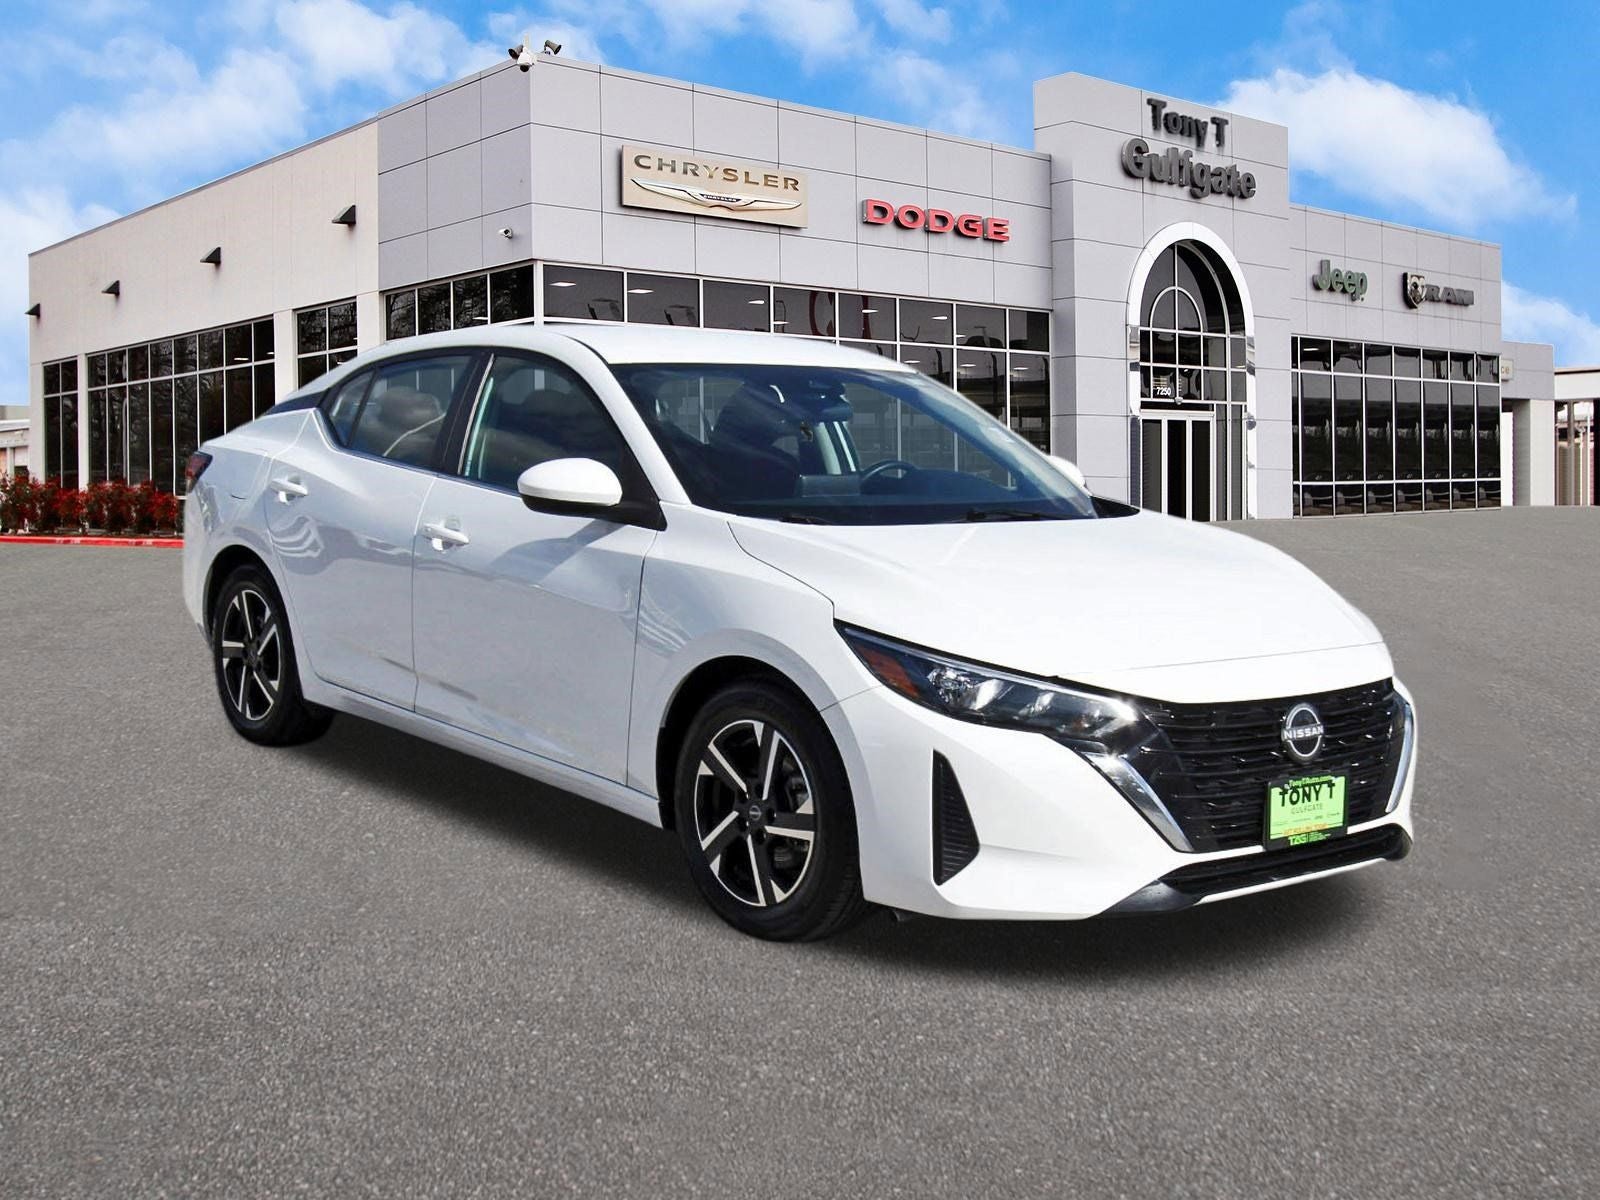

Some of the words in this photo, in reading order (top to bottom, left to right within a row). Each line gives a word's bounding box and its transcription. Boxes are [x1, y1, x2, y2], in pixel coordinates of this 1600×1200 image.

[1146, 98, 1208, 148] Tony
[1210, 116, 1229, 148] T
[633, 154, 800, 192] CHRYSLER
[1120, 138, 1257, 200] Gulfgate
[862, 199, 1010, 243] DODGE
[1312, 259, 1369, 302] Jeep
[1425, 283, 1476, 307] RAM
[1156, 386, 1172, 396] 7250
[1283, 725, 1324, 740] NISSAN
[1279, 783, 1323, 807] TONY
[1327, 780, 1336, 799] T
